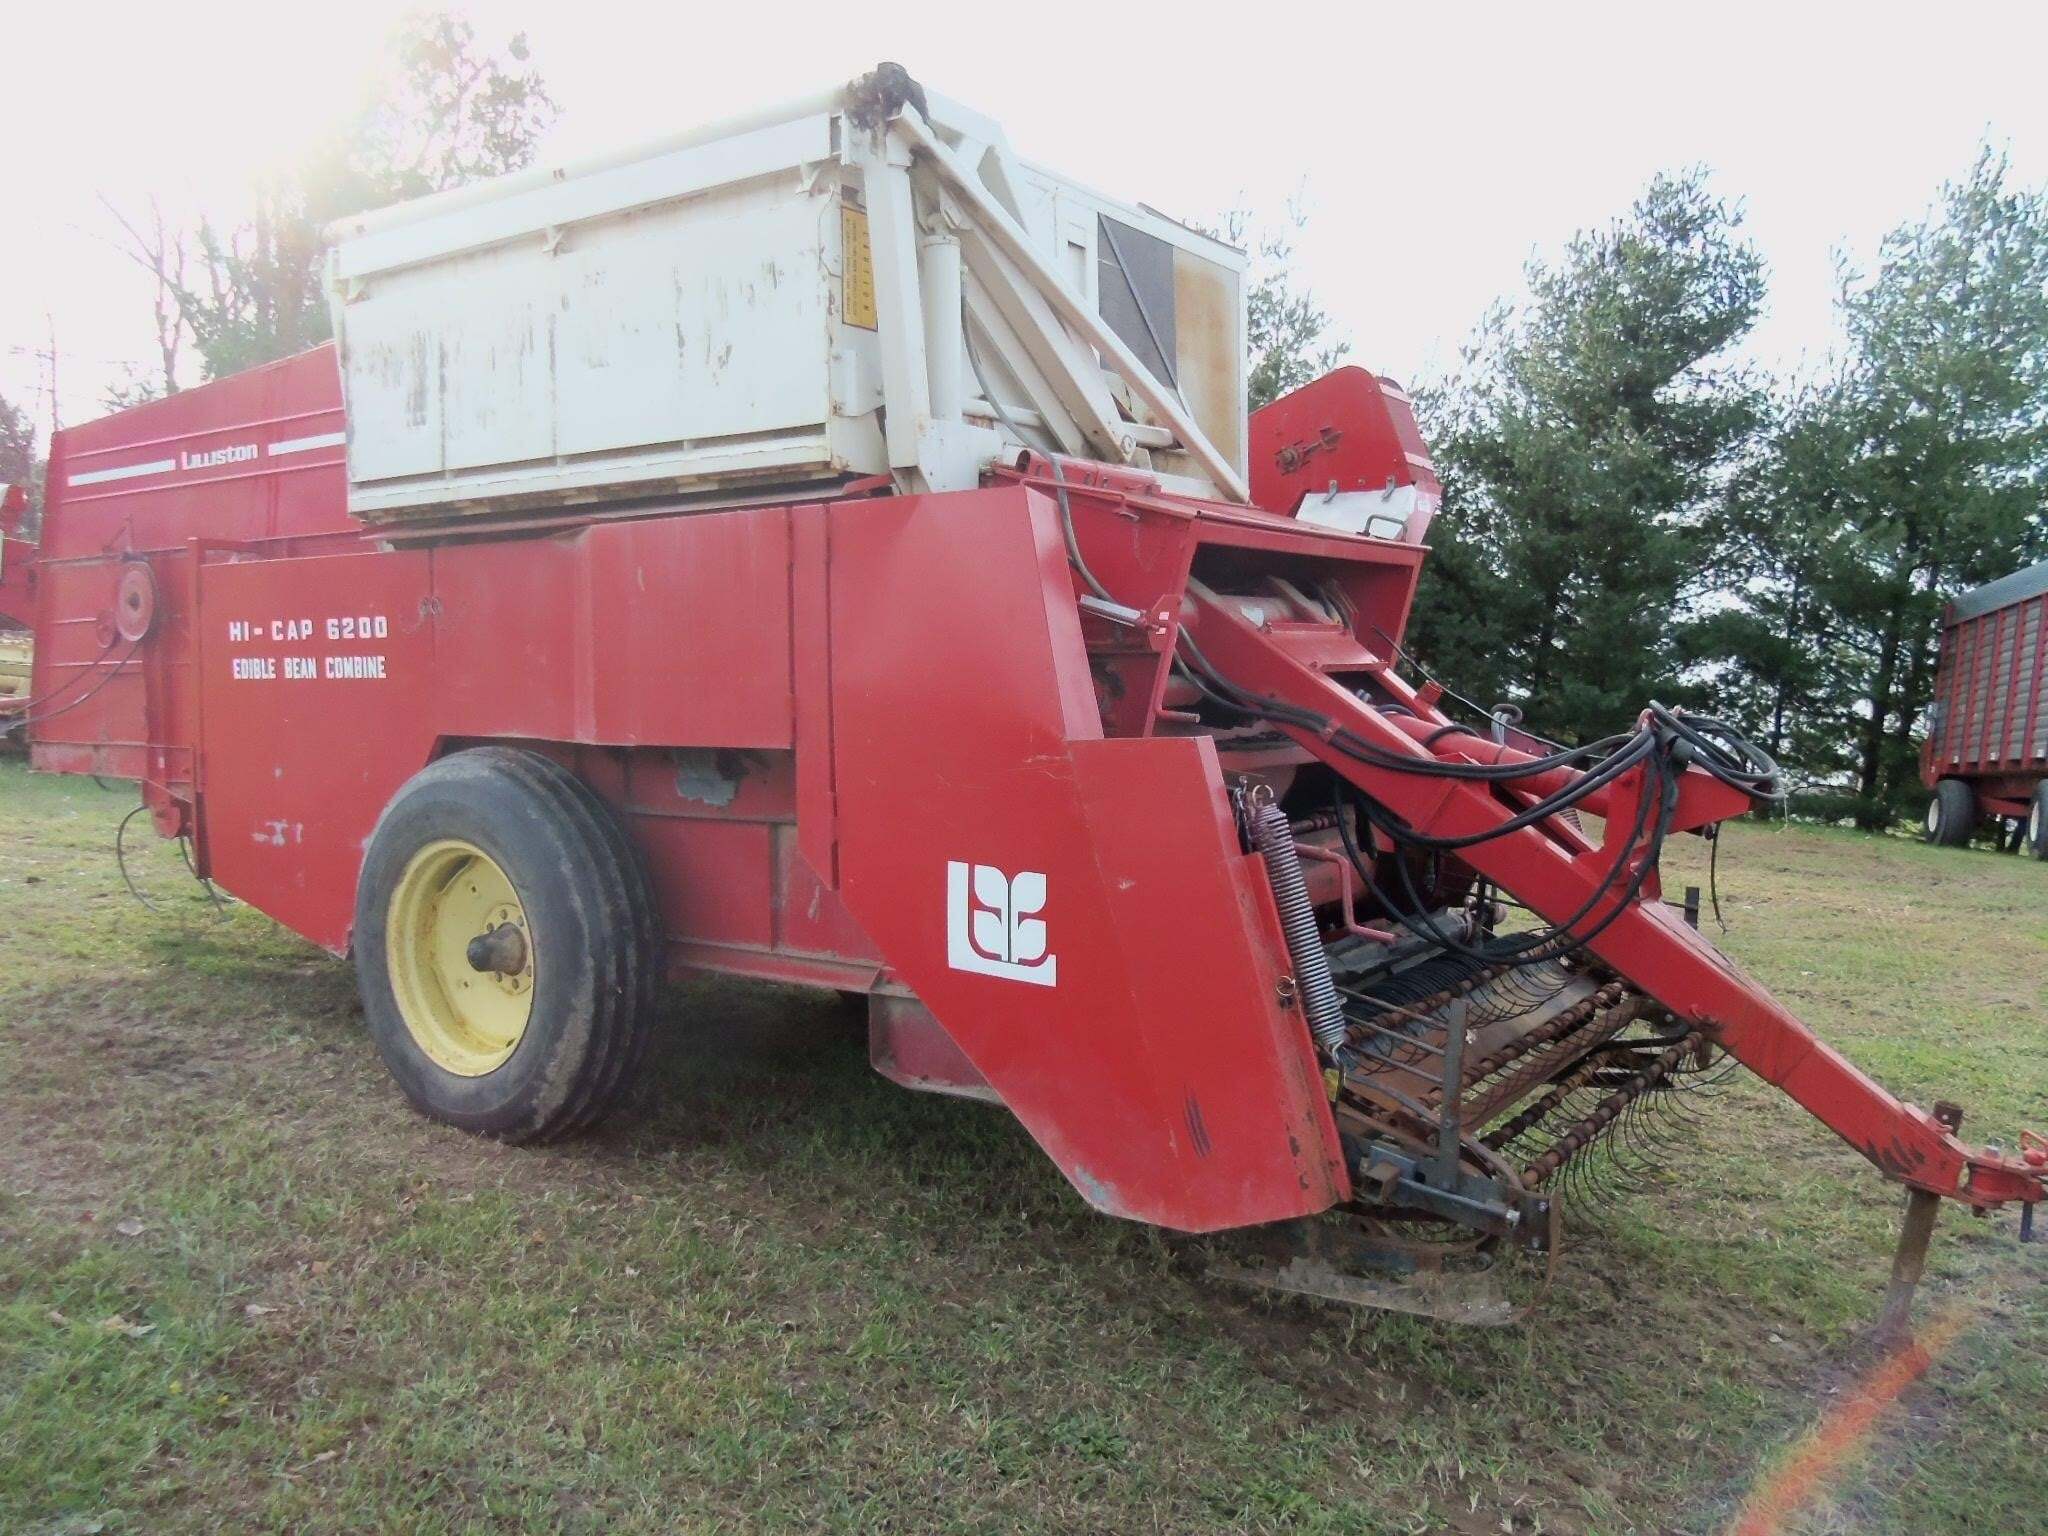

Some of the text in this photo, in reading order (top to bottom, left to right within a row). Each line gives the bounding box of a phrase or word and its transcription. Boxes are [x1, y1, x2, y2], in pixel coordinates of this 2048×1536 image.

[326, 615, 389, 641] 6200
[232, 655, 388, 680] EDIBLE BEAN COMBINE
